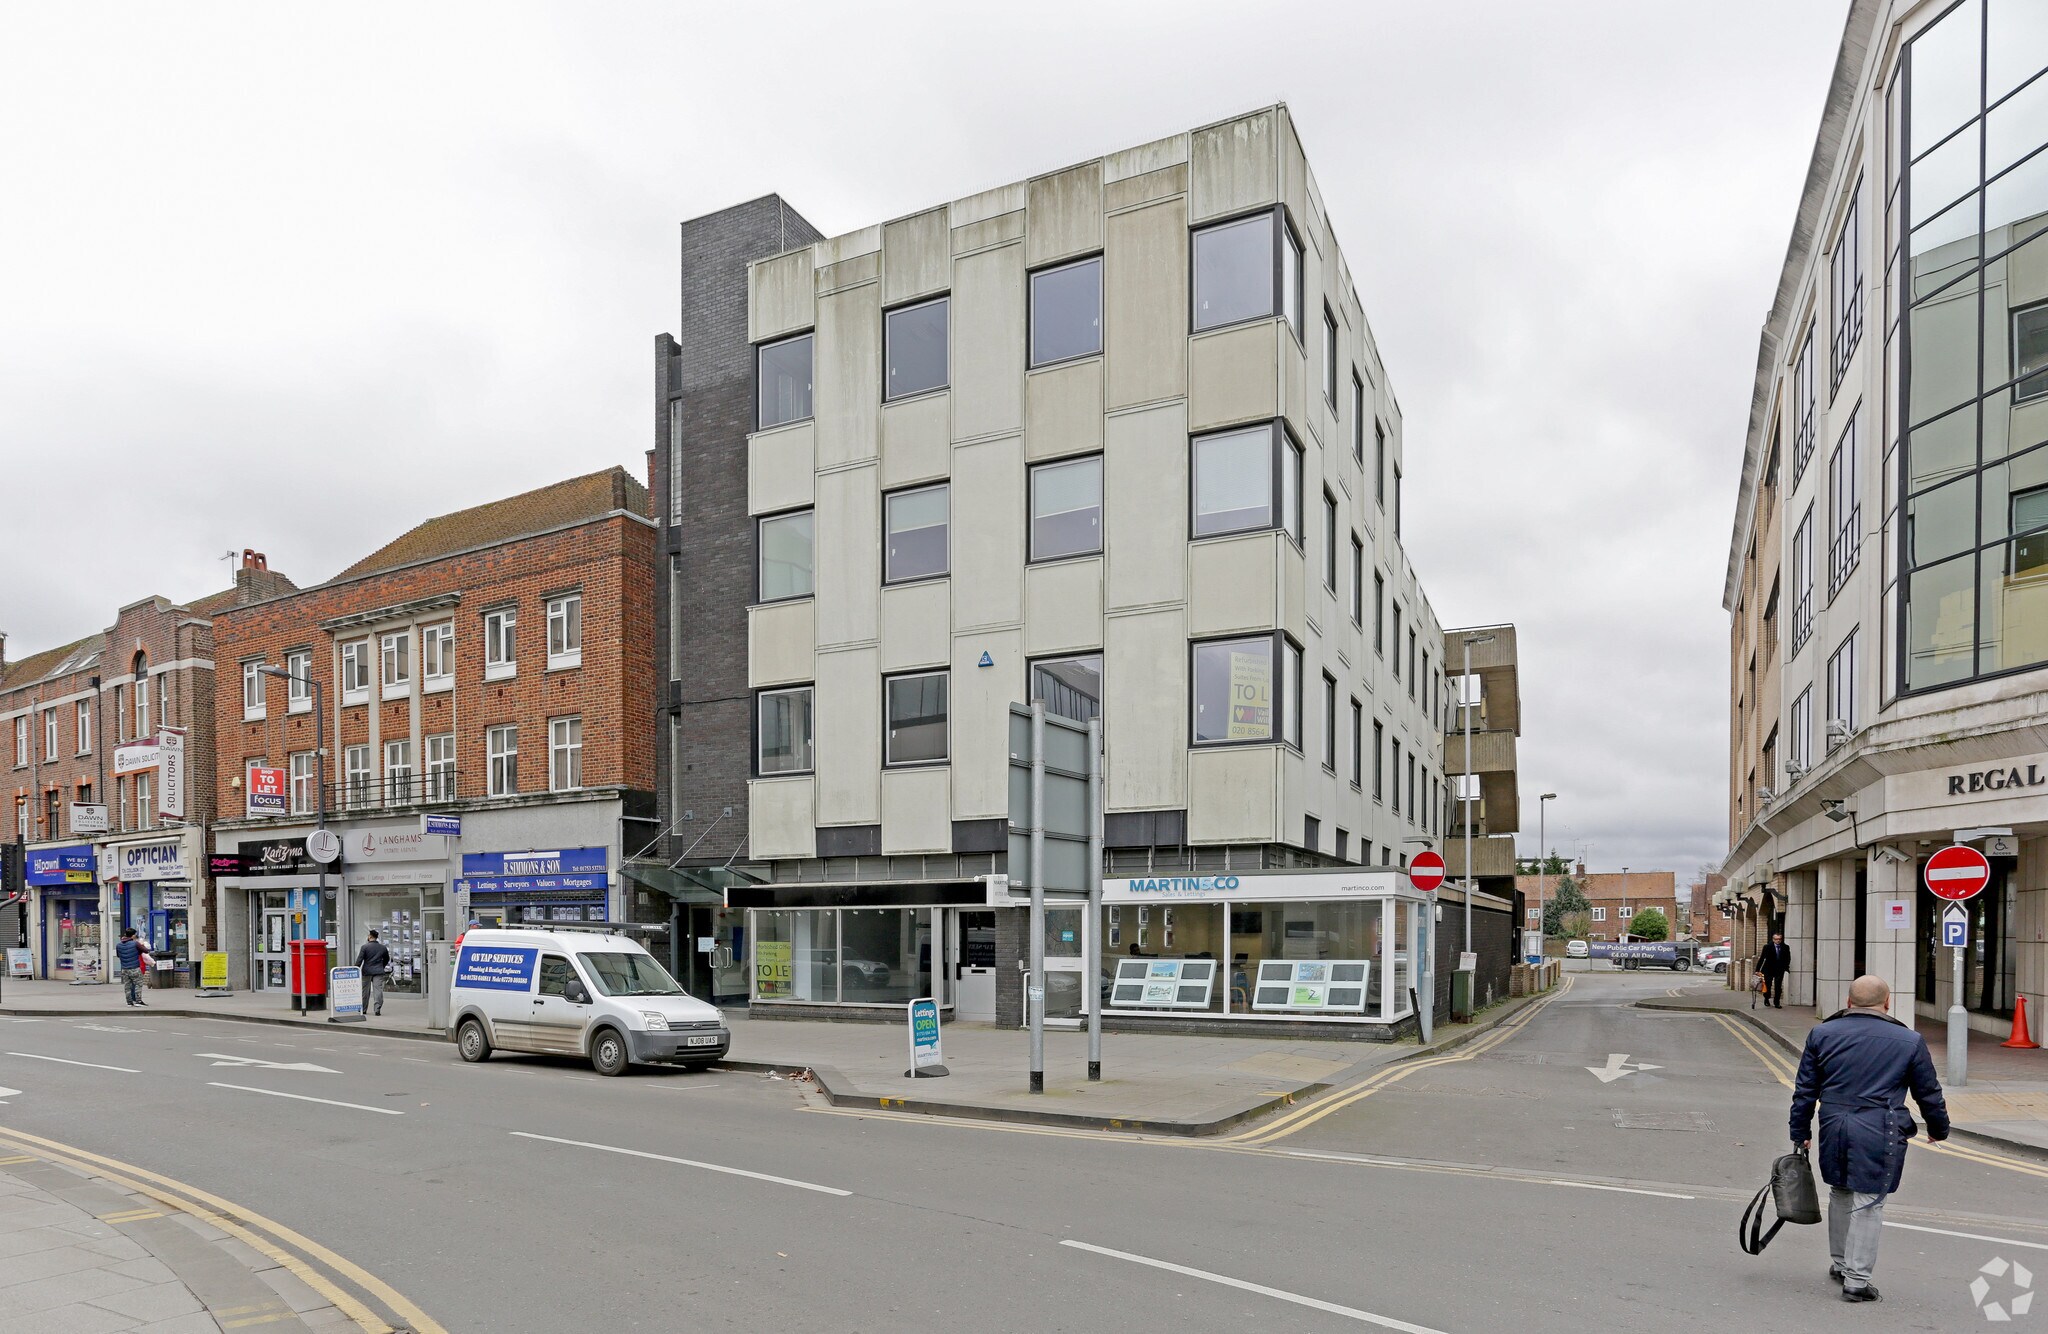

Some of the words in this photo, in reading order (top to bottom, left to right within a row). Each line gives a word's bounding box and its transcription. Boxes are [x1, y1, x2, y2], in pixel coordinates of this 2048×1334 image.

[1234, 683, 1256, 700] TO
[1261, 686, 1268, 701] L
[160, 745, 183, 753] DAWN
[125, 756, 141, 766] DAWN
[141, 752, 160, 763] SOLICIT
[167, 754, 176, 809] SOLICITORS
[260, 775, 275, 784] TO
[1948, 764, 2045, 796] REGAL
[257, 784, 278, 794] LET
[254, 794, 282, 805] focus
[379, 833, 422, 845] LANGHAMS
[127, 844, 178, 867] OPTICIAN
[539, 860, 546, 874] &
[546, 859, 561, 873] SON
[477, 881, 498, 891] Lettings
[503, 880, 530, 889] Surveyors
[536, 878, 556, 888] Valuers
[563, 877, 592, 888] Mortgages
[1341, 884, 1385, 892] martinco.com
[1948, 924, 1963, 943] P
[1591, 943, 1606, 951] New
[1657, 945, 1675, 953] Open
[480, 953, 493, 963] TAP
[492, 953, 525, 964] SERVICES
[757, 964, 772, 977] TO
[914, 1009, 935, 1018] Lettings
[915, 1019, 936, 1031] OPEN
[690, 1037, 705, 1046] NJ08
[705, 1036, 716, 1044] UAS
